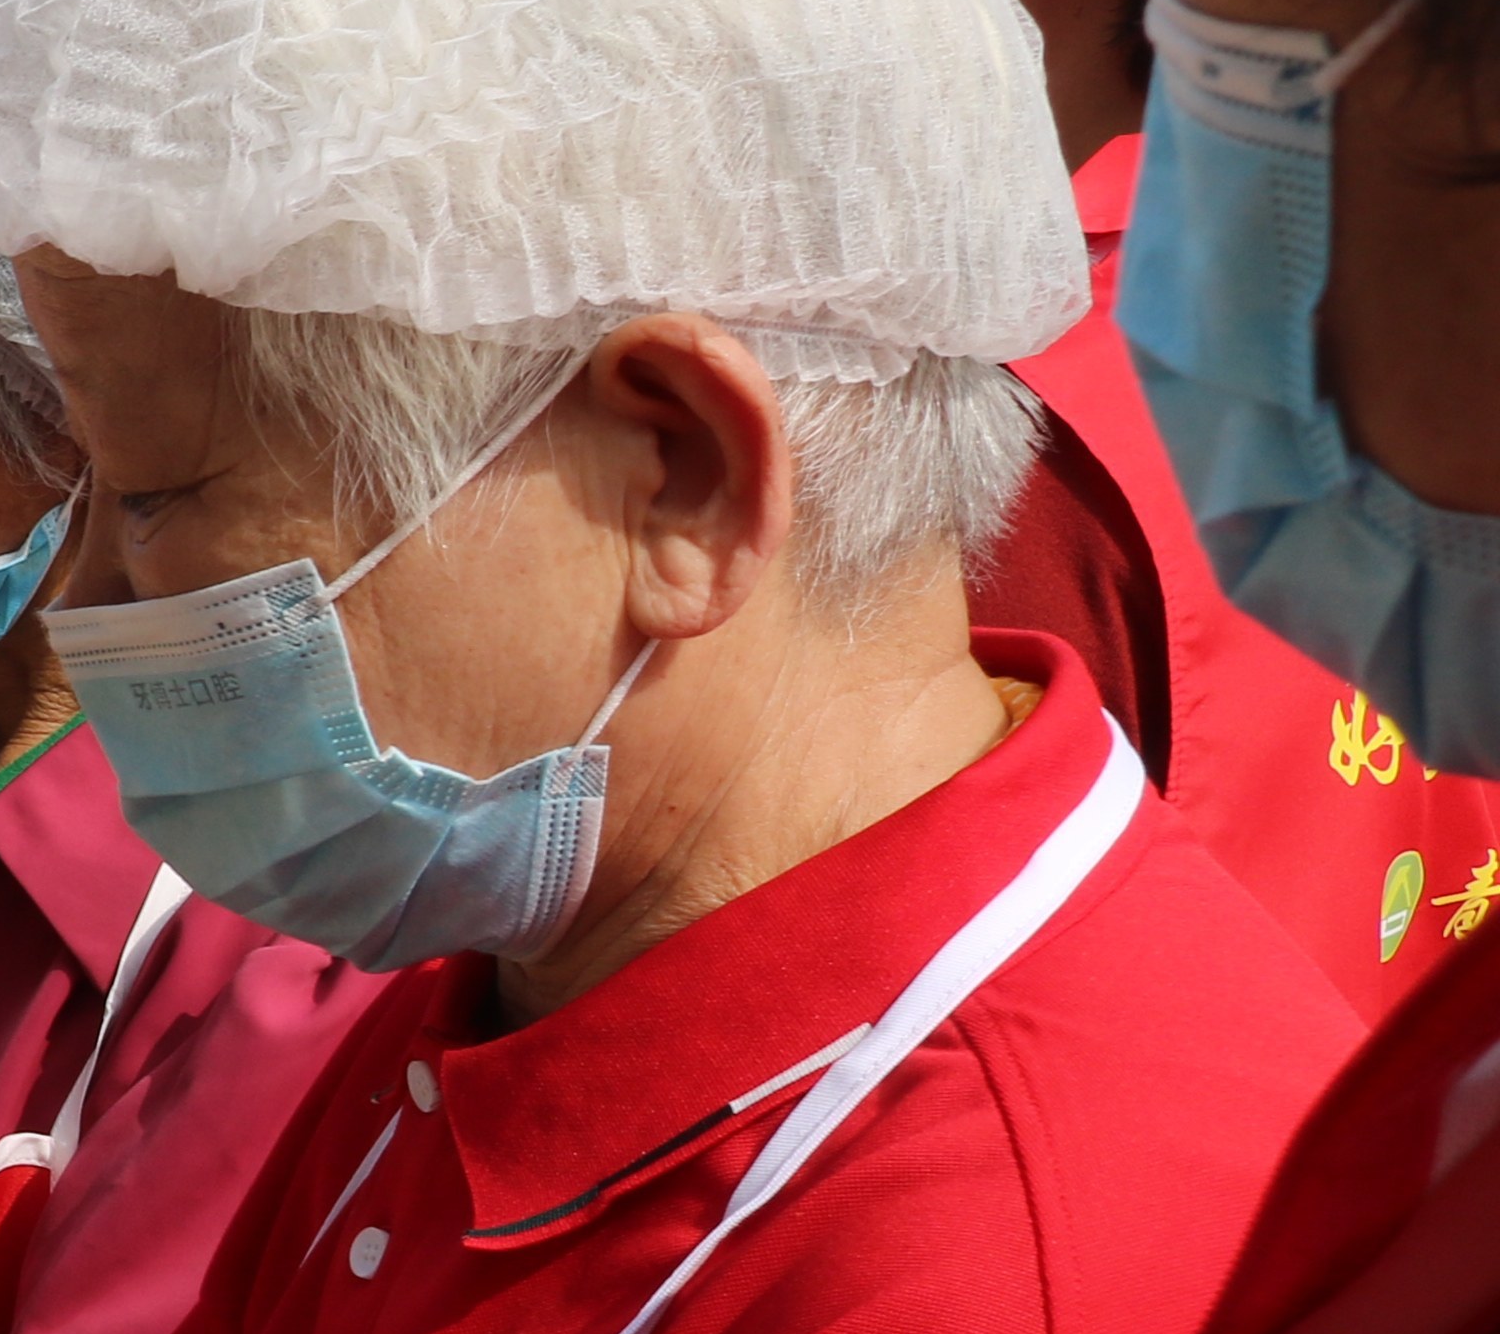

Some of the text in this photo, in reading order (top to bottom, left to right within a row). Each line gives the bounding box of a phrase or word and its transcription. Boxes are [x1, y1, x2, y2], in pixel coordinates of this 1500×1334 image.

[129, 671, 245, 710] 牙博士口腔
